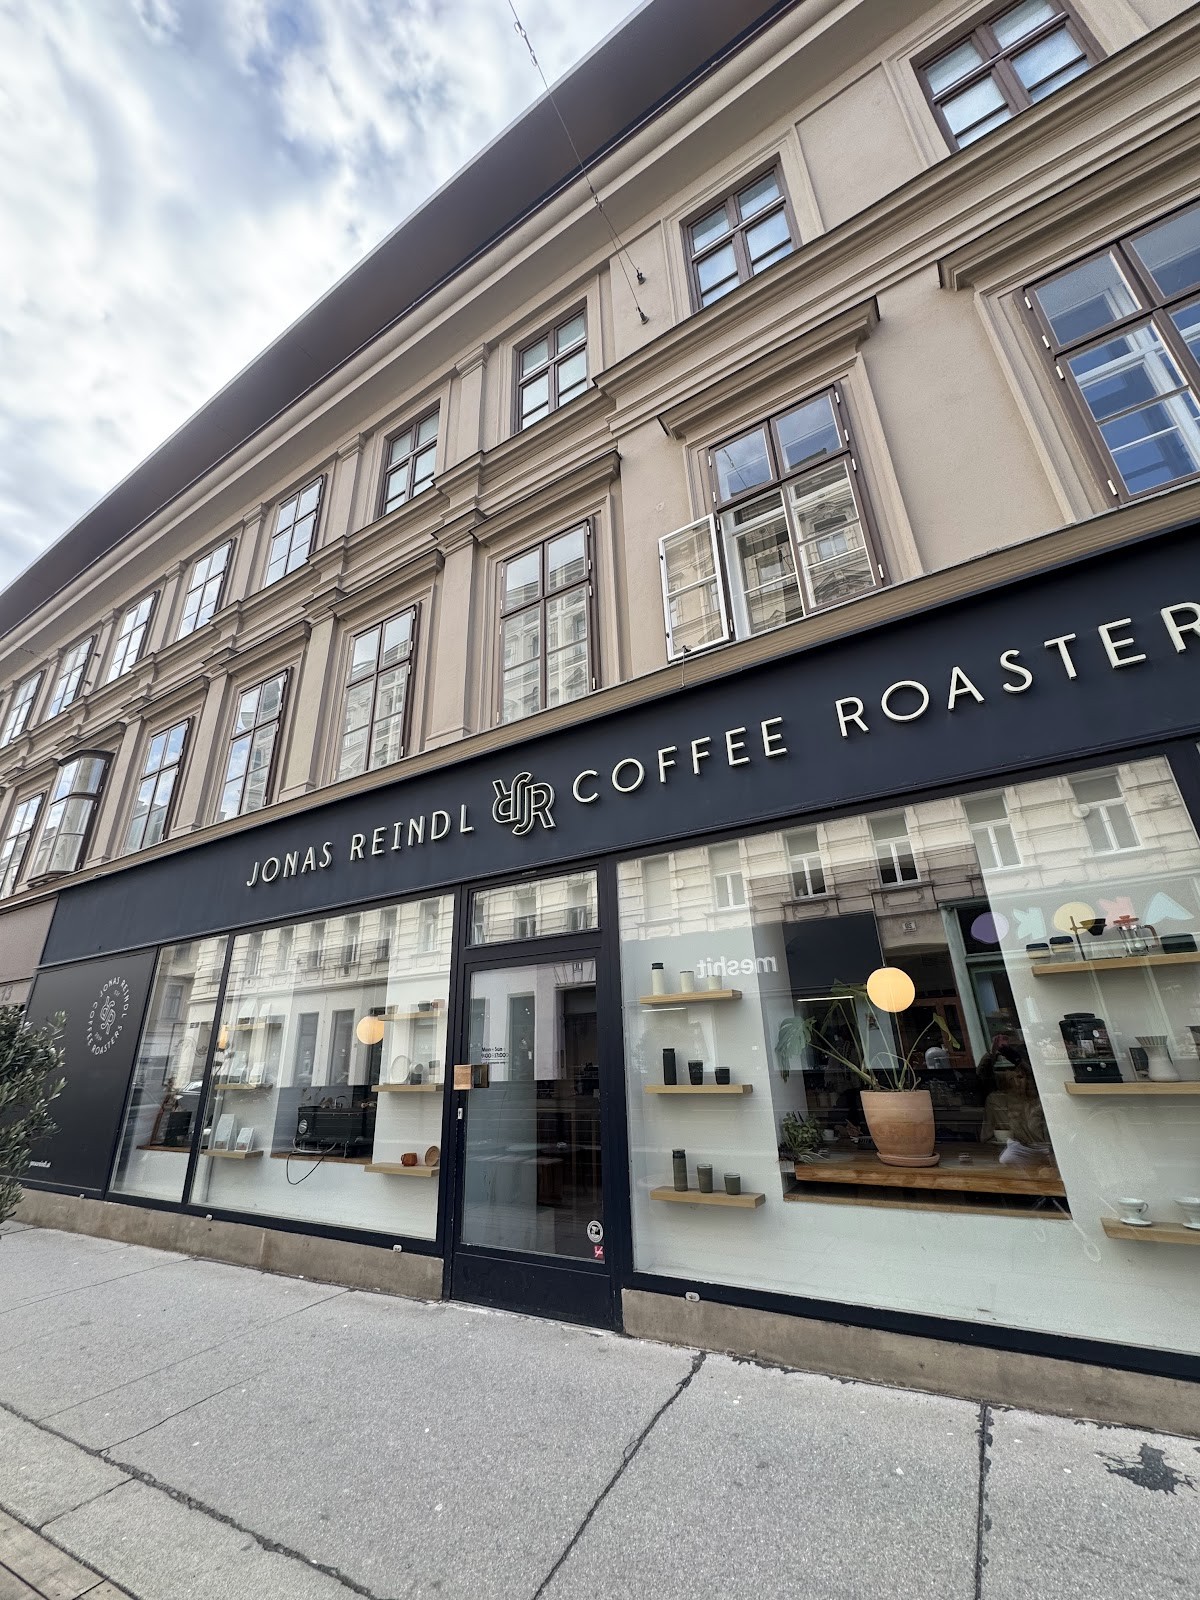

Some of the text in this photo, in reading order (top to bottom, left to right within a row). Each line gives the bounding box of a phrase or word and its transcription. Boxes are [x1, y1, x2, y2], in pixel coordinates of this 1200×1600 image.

[246, 841, 333, 887] JONAS
[349, 803, 474, 861] REINDL
[572, 716, 788, 803] COFFEE
[835, 602, 1200, 738] ROASTER
[100, 976, 130, 1019] JONAS REINDL
[90, 1025, 123, 1056] ROASTERS
